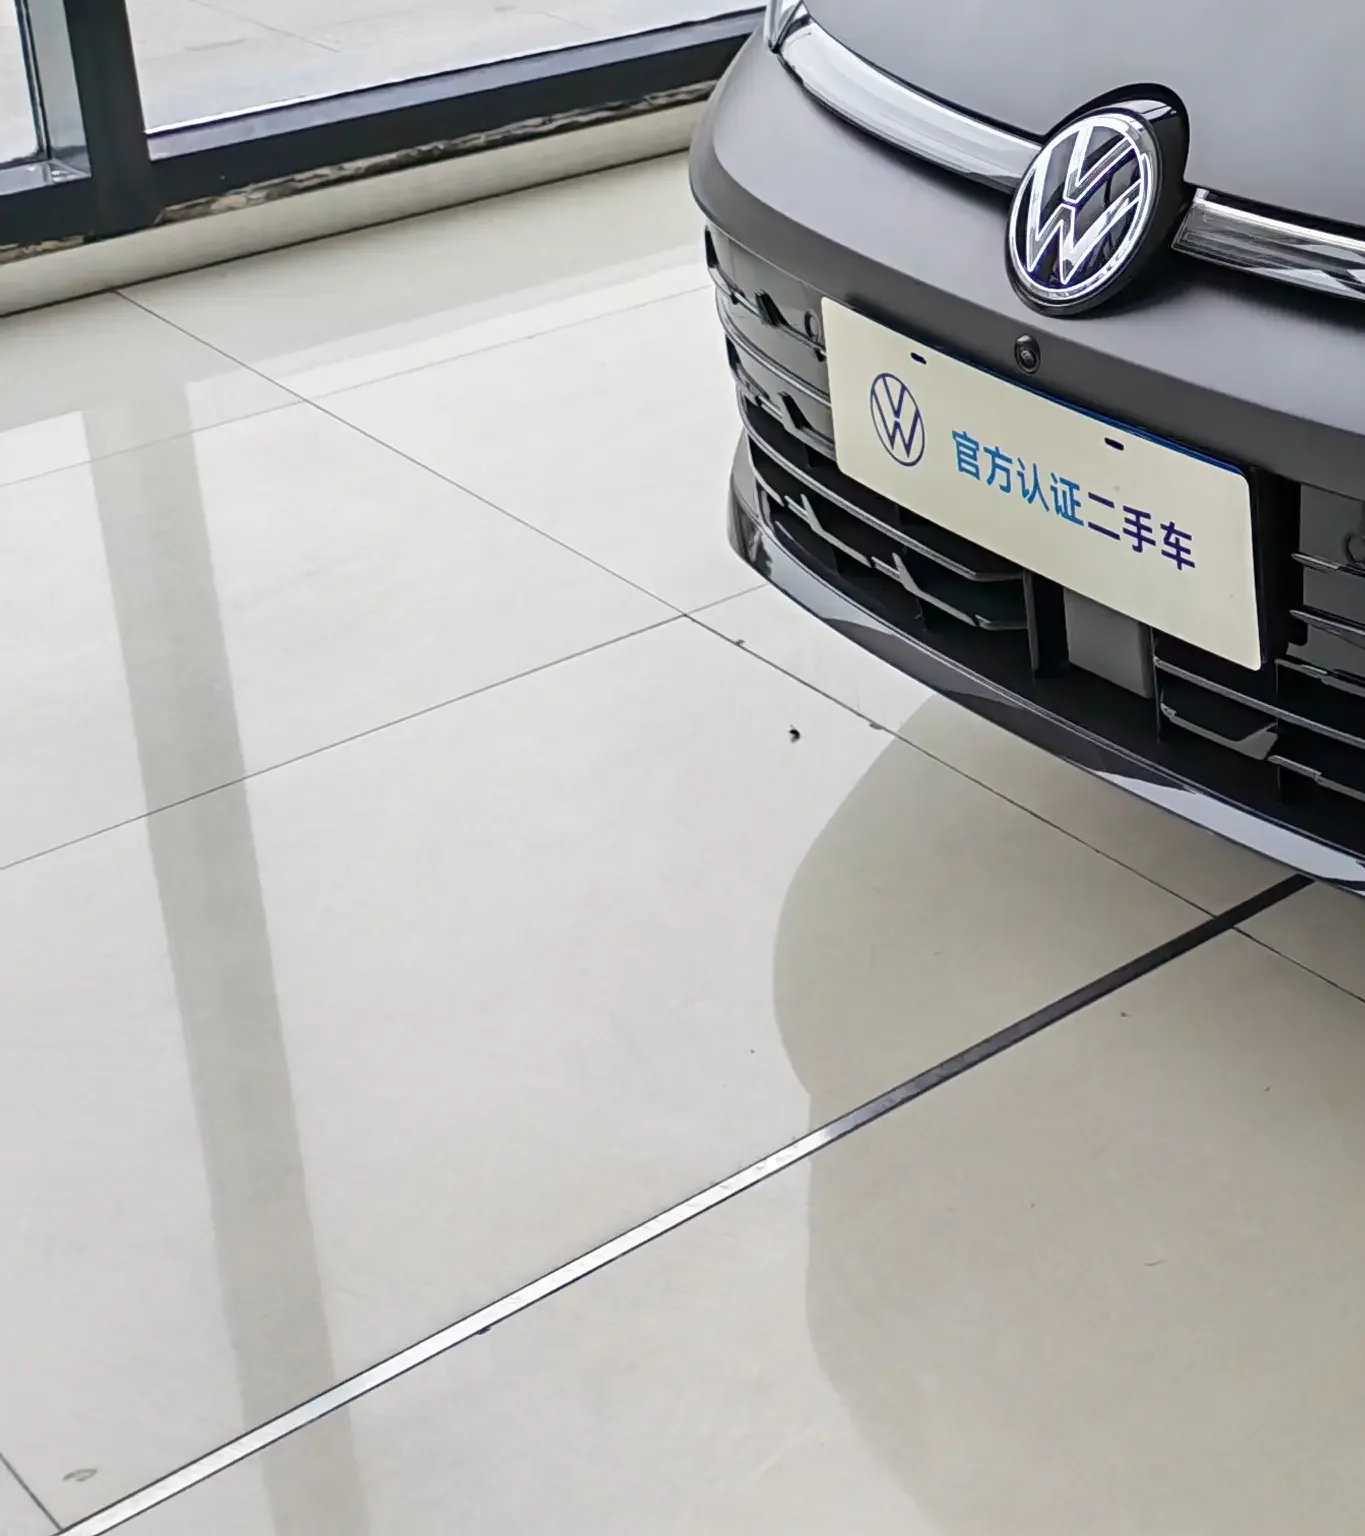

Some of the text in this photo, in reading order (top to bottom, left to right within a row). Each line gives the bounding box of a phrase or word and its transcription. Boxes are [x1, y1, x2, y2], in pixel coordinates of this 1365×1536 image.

[951, 429, 1196, 572] 官方认证二手车
